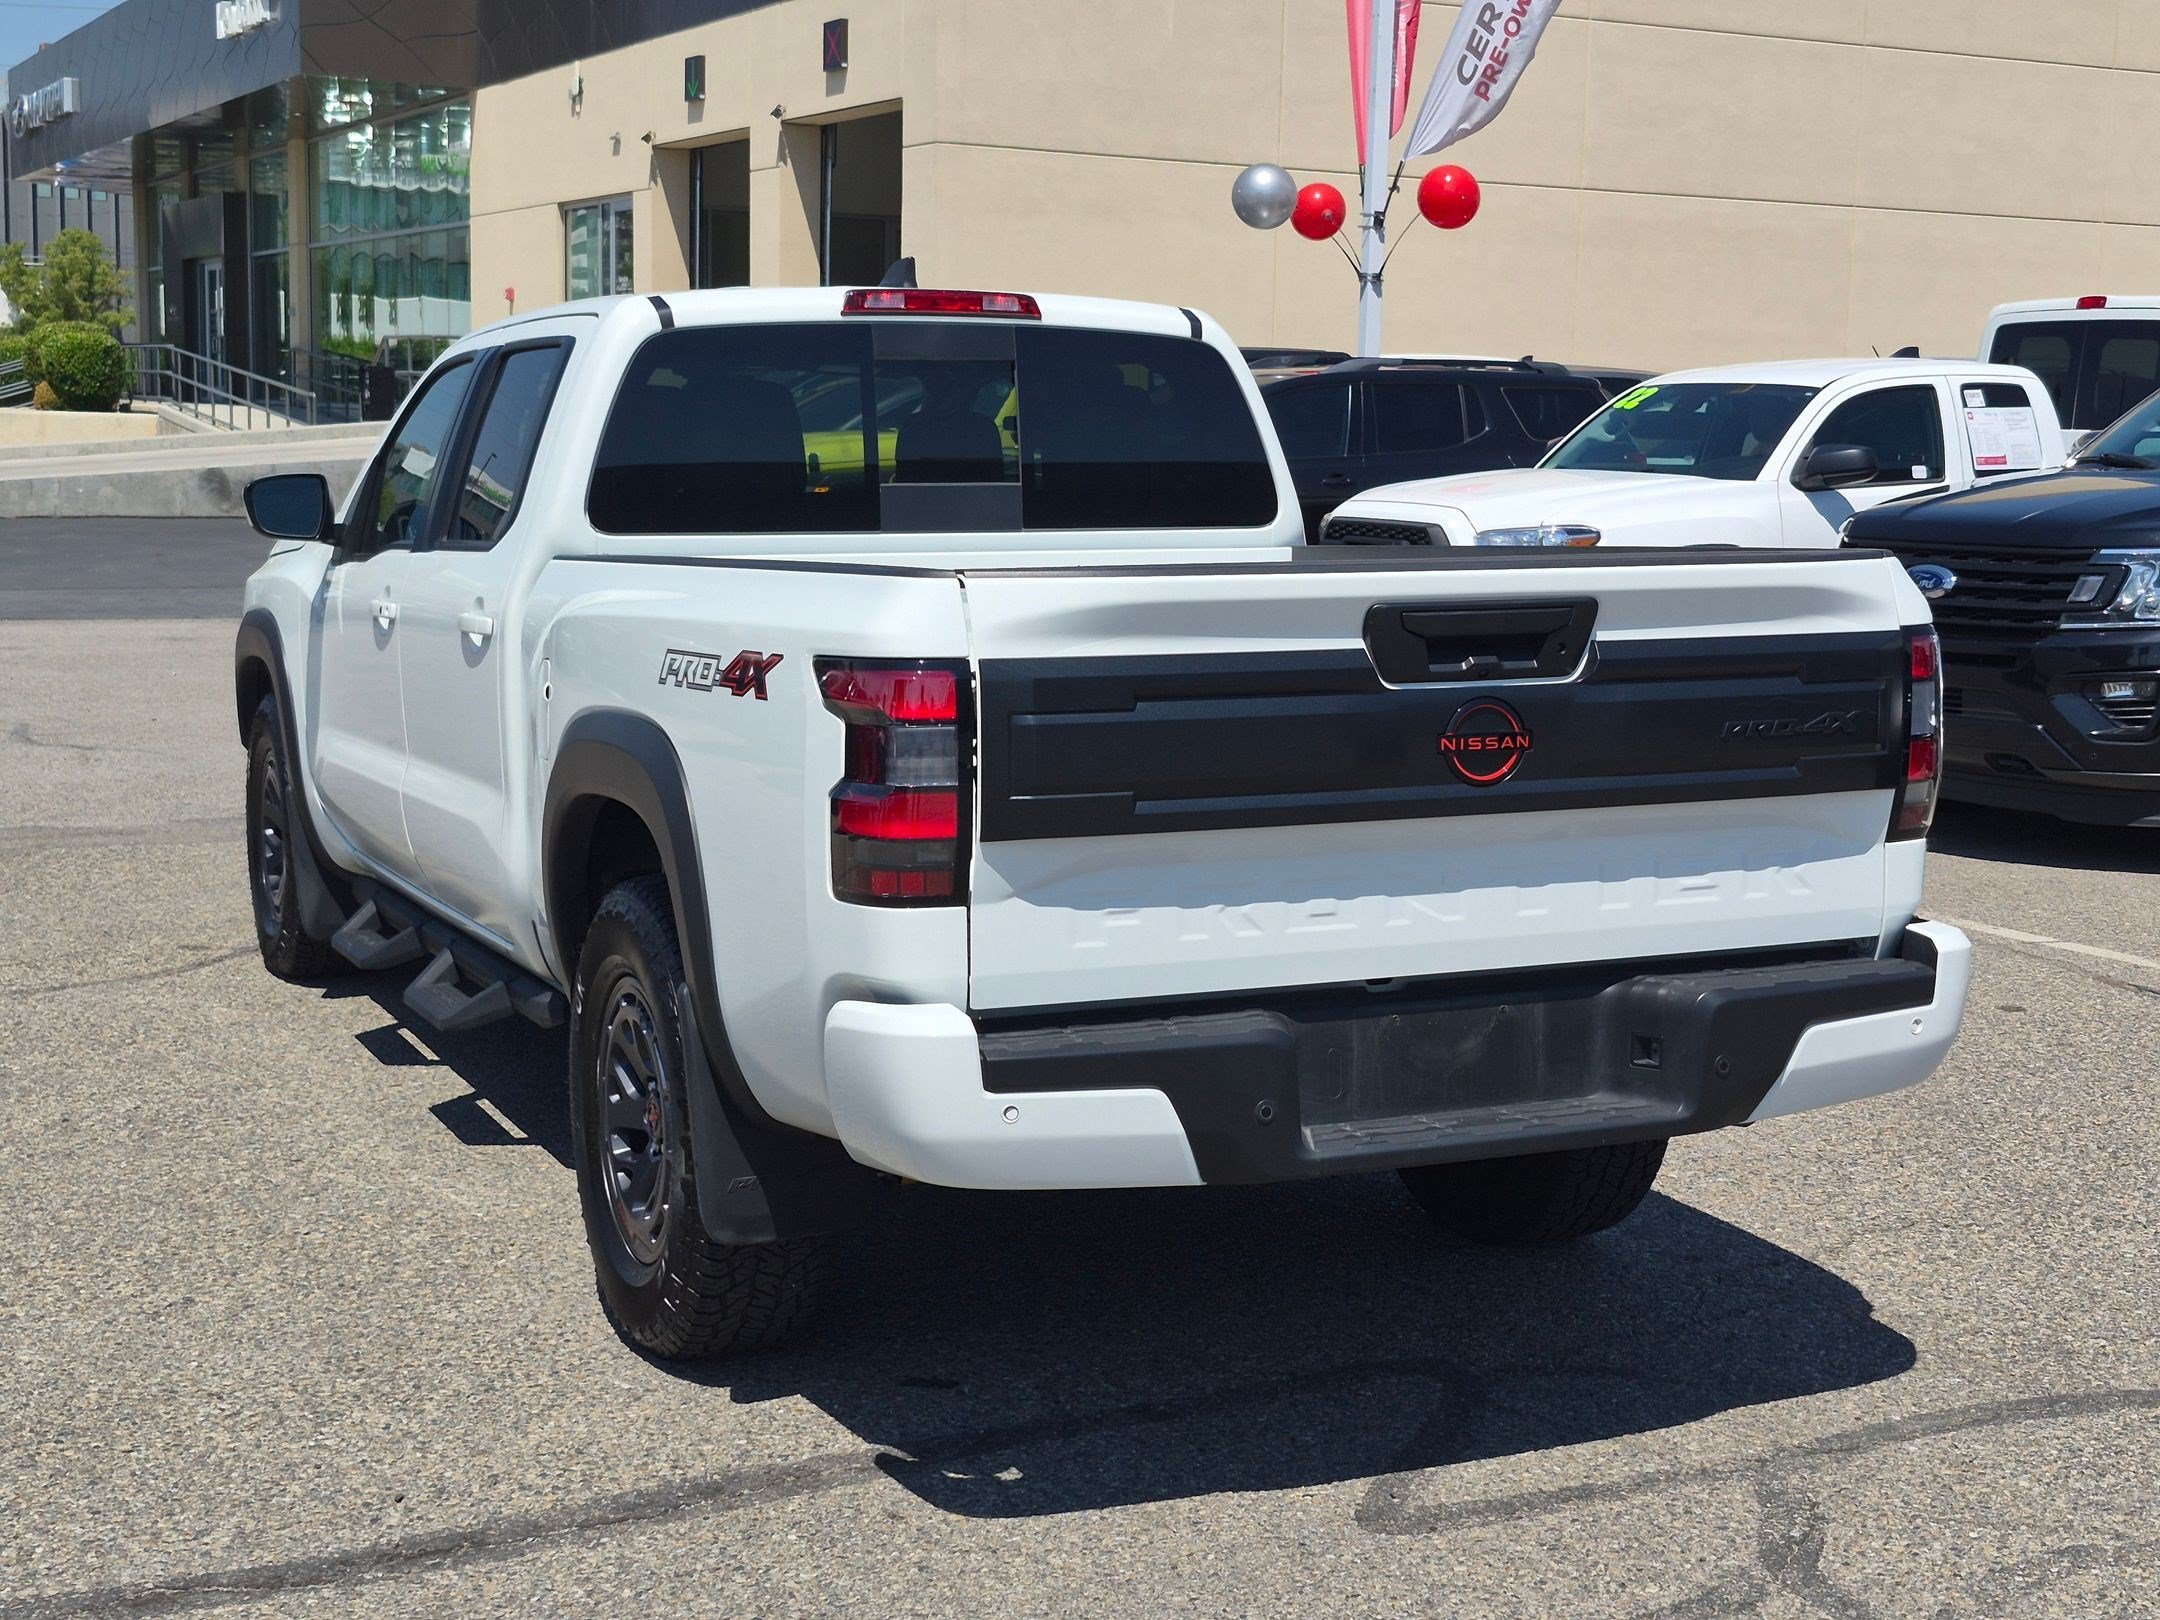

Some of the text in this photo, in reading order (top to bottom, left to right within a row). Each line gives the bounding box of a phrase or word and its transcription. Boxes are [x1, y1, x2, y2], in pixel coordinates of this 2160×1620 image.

[1457, 1, 1504, 86] CER
[658, 648, 784, 701] PRO-4X
[1440, 735, 1530, 752] NISSAN
